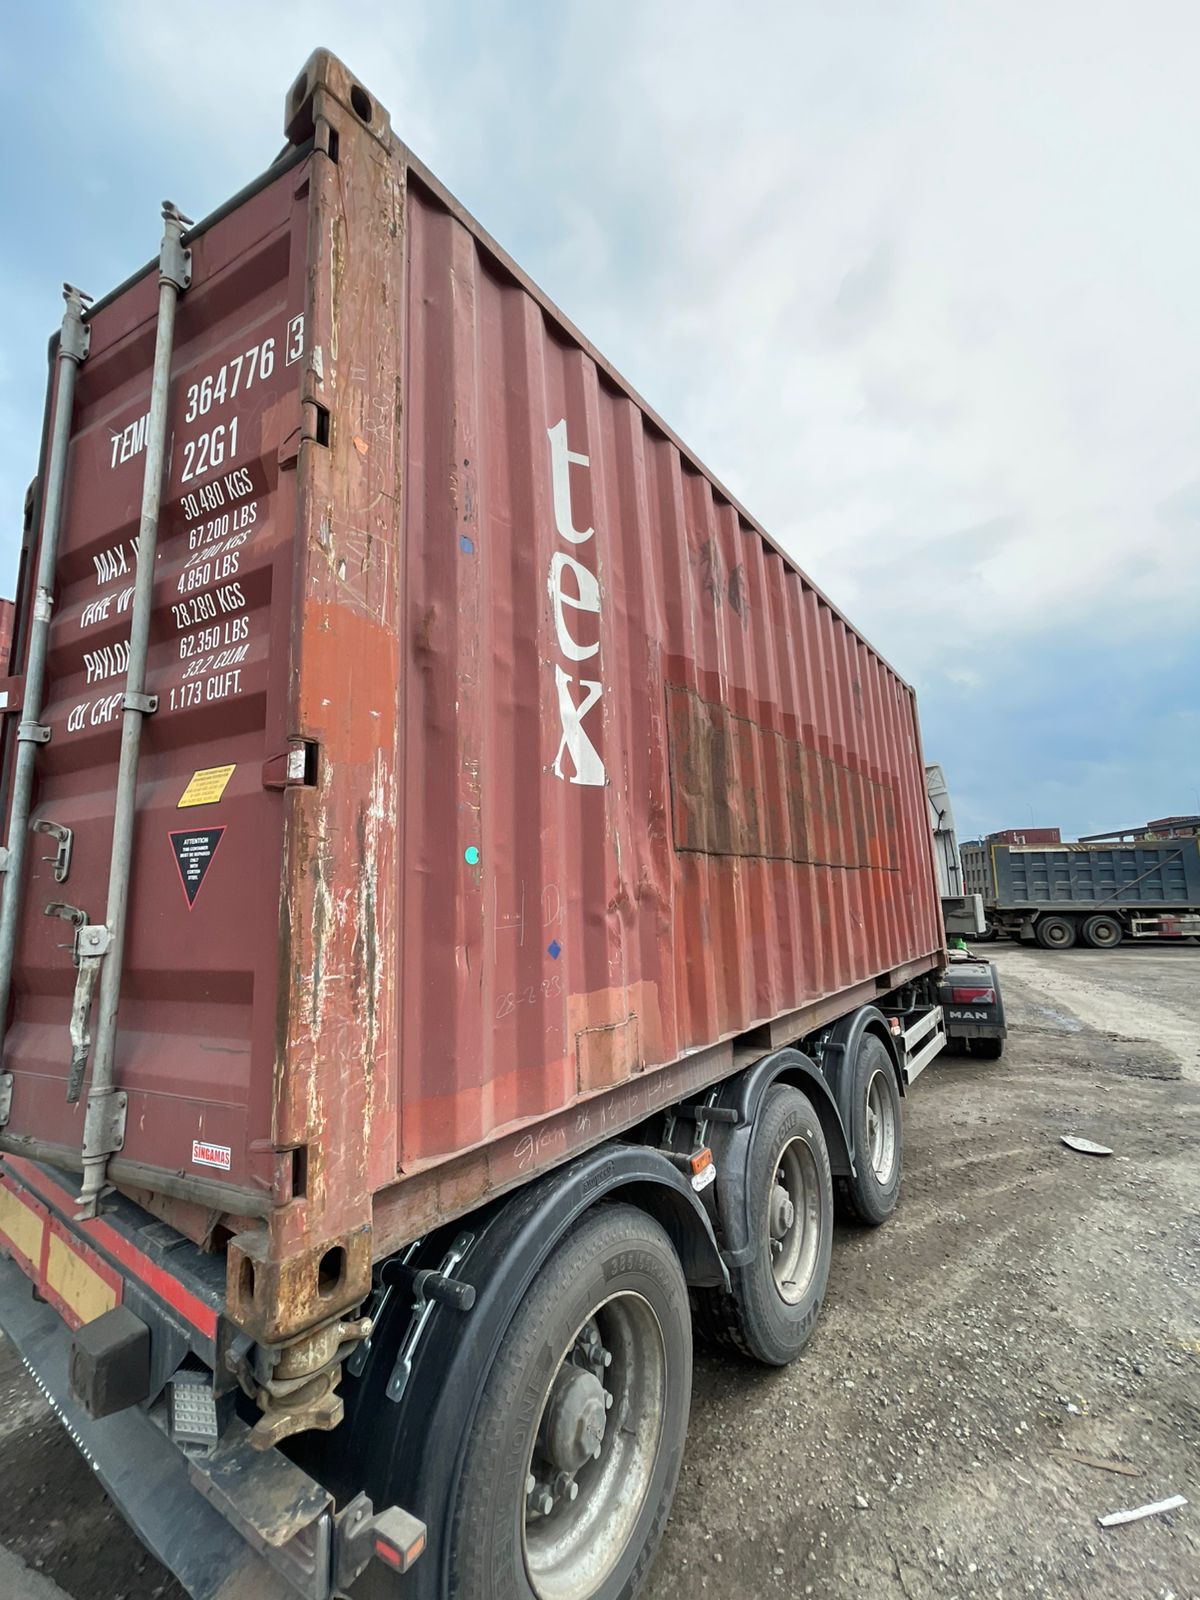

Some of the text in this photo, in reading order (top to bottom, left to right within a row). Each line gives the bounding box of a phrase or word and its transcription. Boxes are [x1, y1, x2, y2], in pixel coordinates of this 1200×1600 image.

[184, 337, 275, 424] 364776
[290, 315, 304, 360] 3
[180, 416, 239, 483] 22G1
[93, 543, 131, 586] MAX.
[180, 481, 225, 521] 30.480
[224, 471, 253, 501] KGS
[188, 501, 257, 550] 67.200 LBS
[80, 593, 118, 628] TARE
[221, 529, 252, 553] KGS
[177, 551, 240, 594] 4.850 LBS
[83, 582, 246, 684] PAYLOA 28.280 KGS
[179, 616, 249, 659] 62.350 LBS
[67, 702, 91, 732] CU.
[90, 692, 123, 726] CAP.
[181, 655, 215, 679] 33.2
[169, 669, 242, 711] 1.173 CU.FT.
[949, 1011, 988, 1020] MAN
[194, 1145, 230, 1165] SINGAMAS
